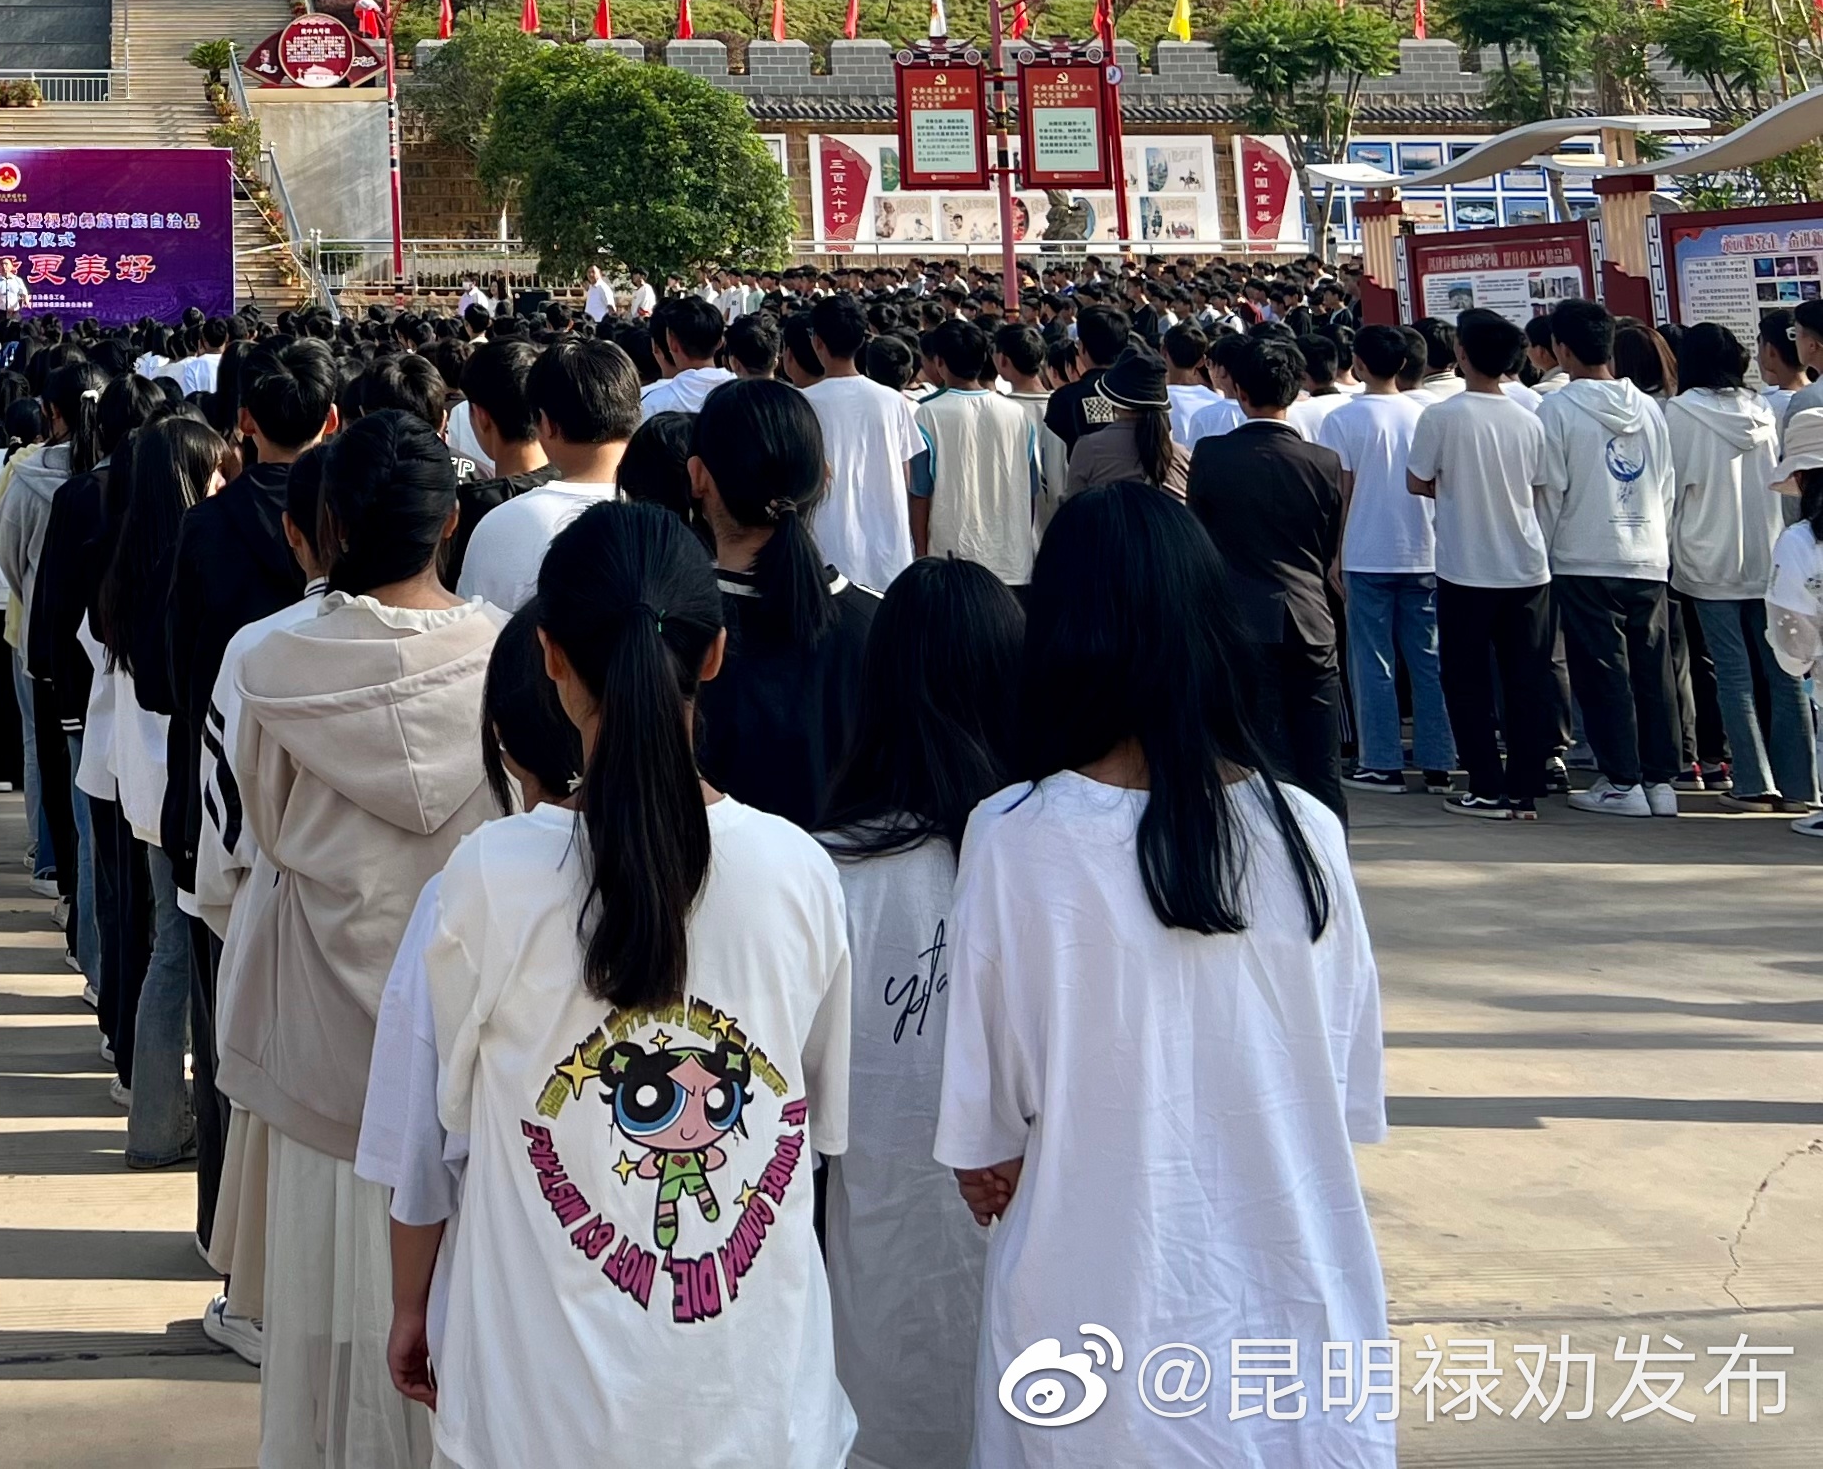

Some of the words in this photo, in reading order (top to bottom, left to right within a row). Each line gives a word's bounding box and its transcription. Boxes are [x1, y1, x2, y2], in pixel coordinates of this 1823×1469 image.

[829, 159, 849, 224] 三百六十行
[1252, 160, 1273, 222] 大国重器
[779, 1096, 809, 1127] IF
[520, 1118, 592, 1229] MISTAKE
[570, 1212, 616, 1261] BY
[601, 1234, 658, 1312] NOT
[672, 1250, 723, 1324] DIE
